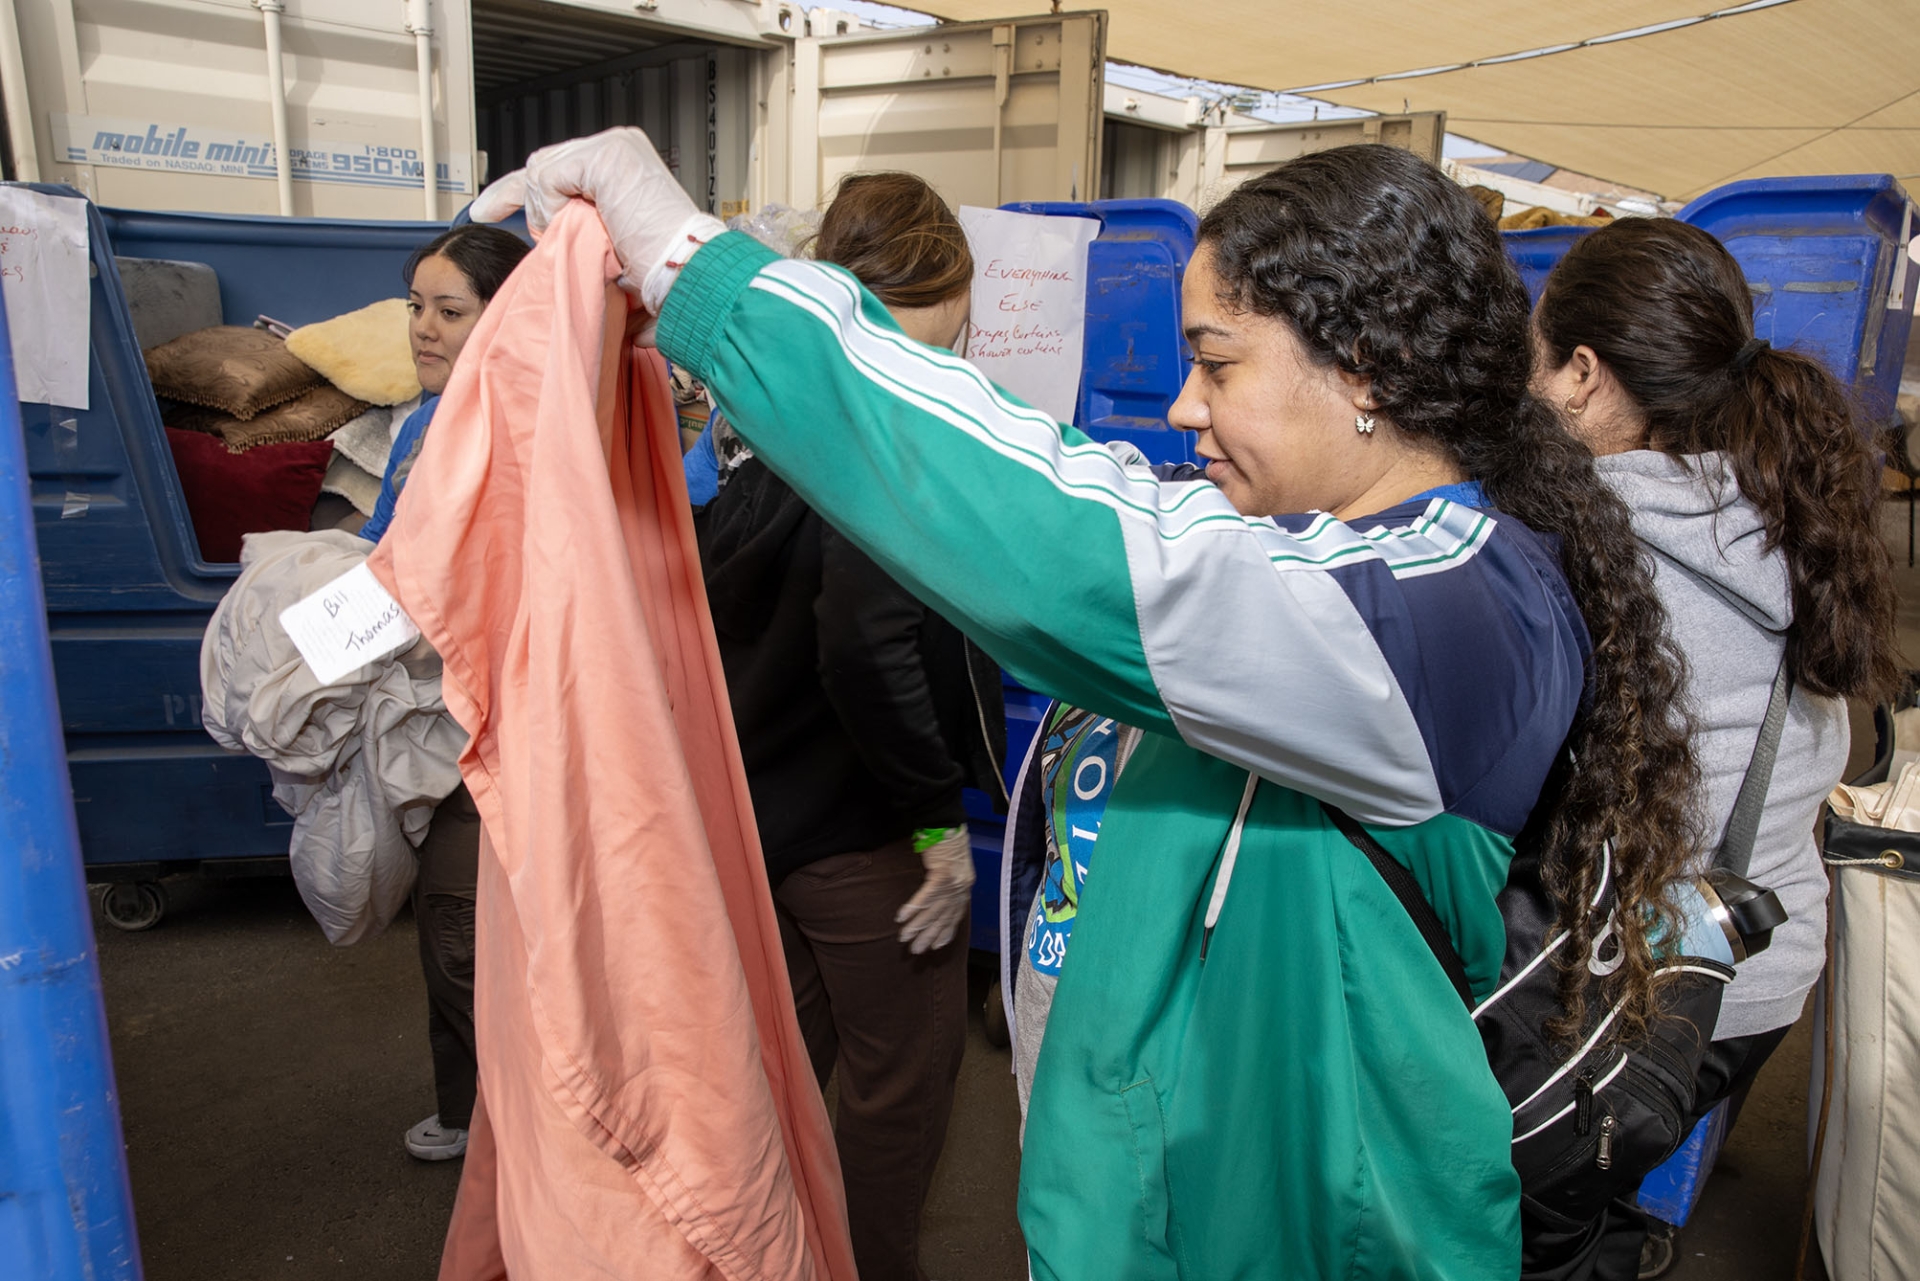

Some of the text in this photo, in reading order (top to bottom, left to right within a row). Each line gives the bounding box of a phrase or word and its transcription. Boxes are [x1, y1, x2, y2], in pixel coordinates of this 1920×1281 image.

[92, 124, 271, 165] mobile mini
[100, 154, 244, 174] Traded on NASDAQ: MINI
[323, 590, 349, 619] Bill
[344, 602, 400, 651] Thomas
